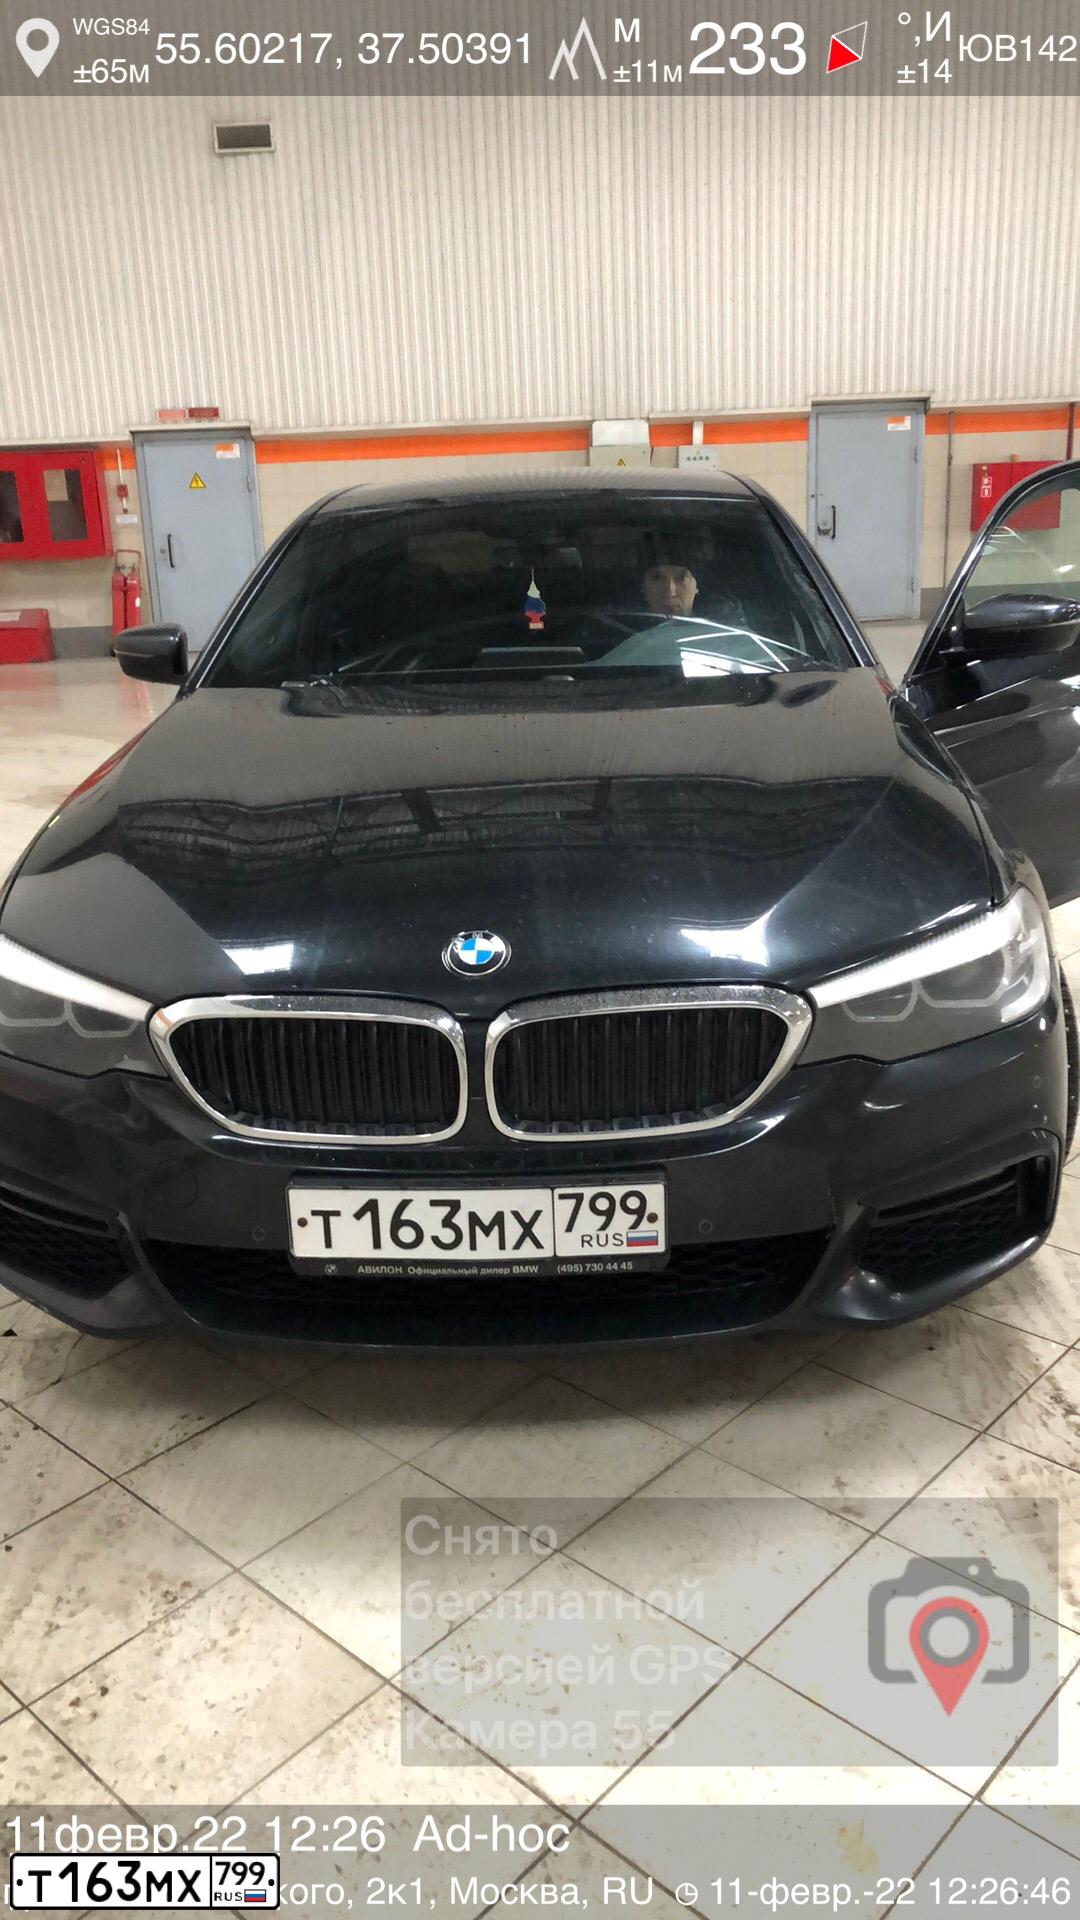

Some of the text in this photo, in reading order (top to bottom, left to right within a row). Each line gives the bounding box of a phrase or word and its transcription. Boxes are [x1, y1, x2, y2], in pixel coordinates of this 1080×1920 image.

[557, 1189, 648, 1233] 799
[580, 1233, 625, 1248] RUS
[357, 1265, 403, 1275] АВИЛОН
[406, 1265, 479, 1276] Официальный
[512, 1264, 539, 1274] BMW
[556, 1263, 583, 1275] (495)
[584, 1262, 604, 1272] 730
[605, 1261, 619, 1271] 44
[620, 1260, 634, 1270] 45
